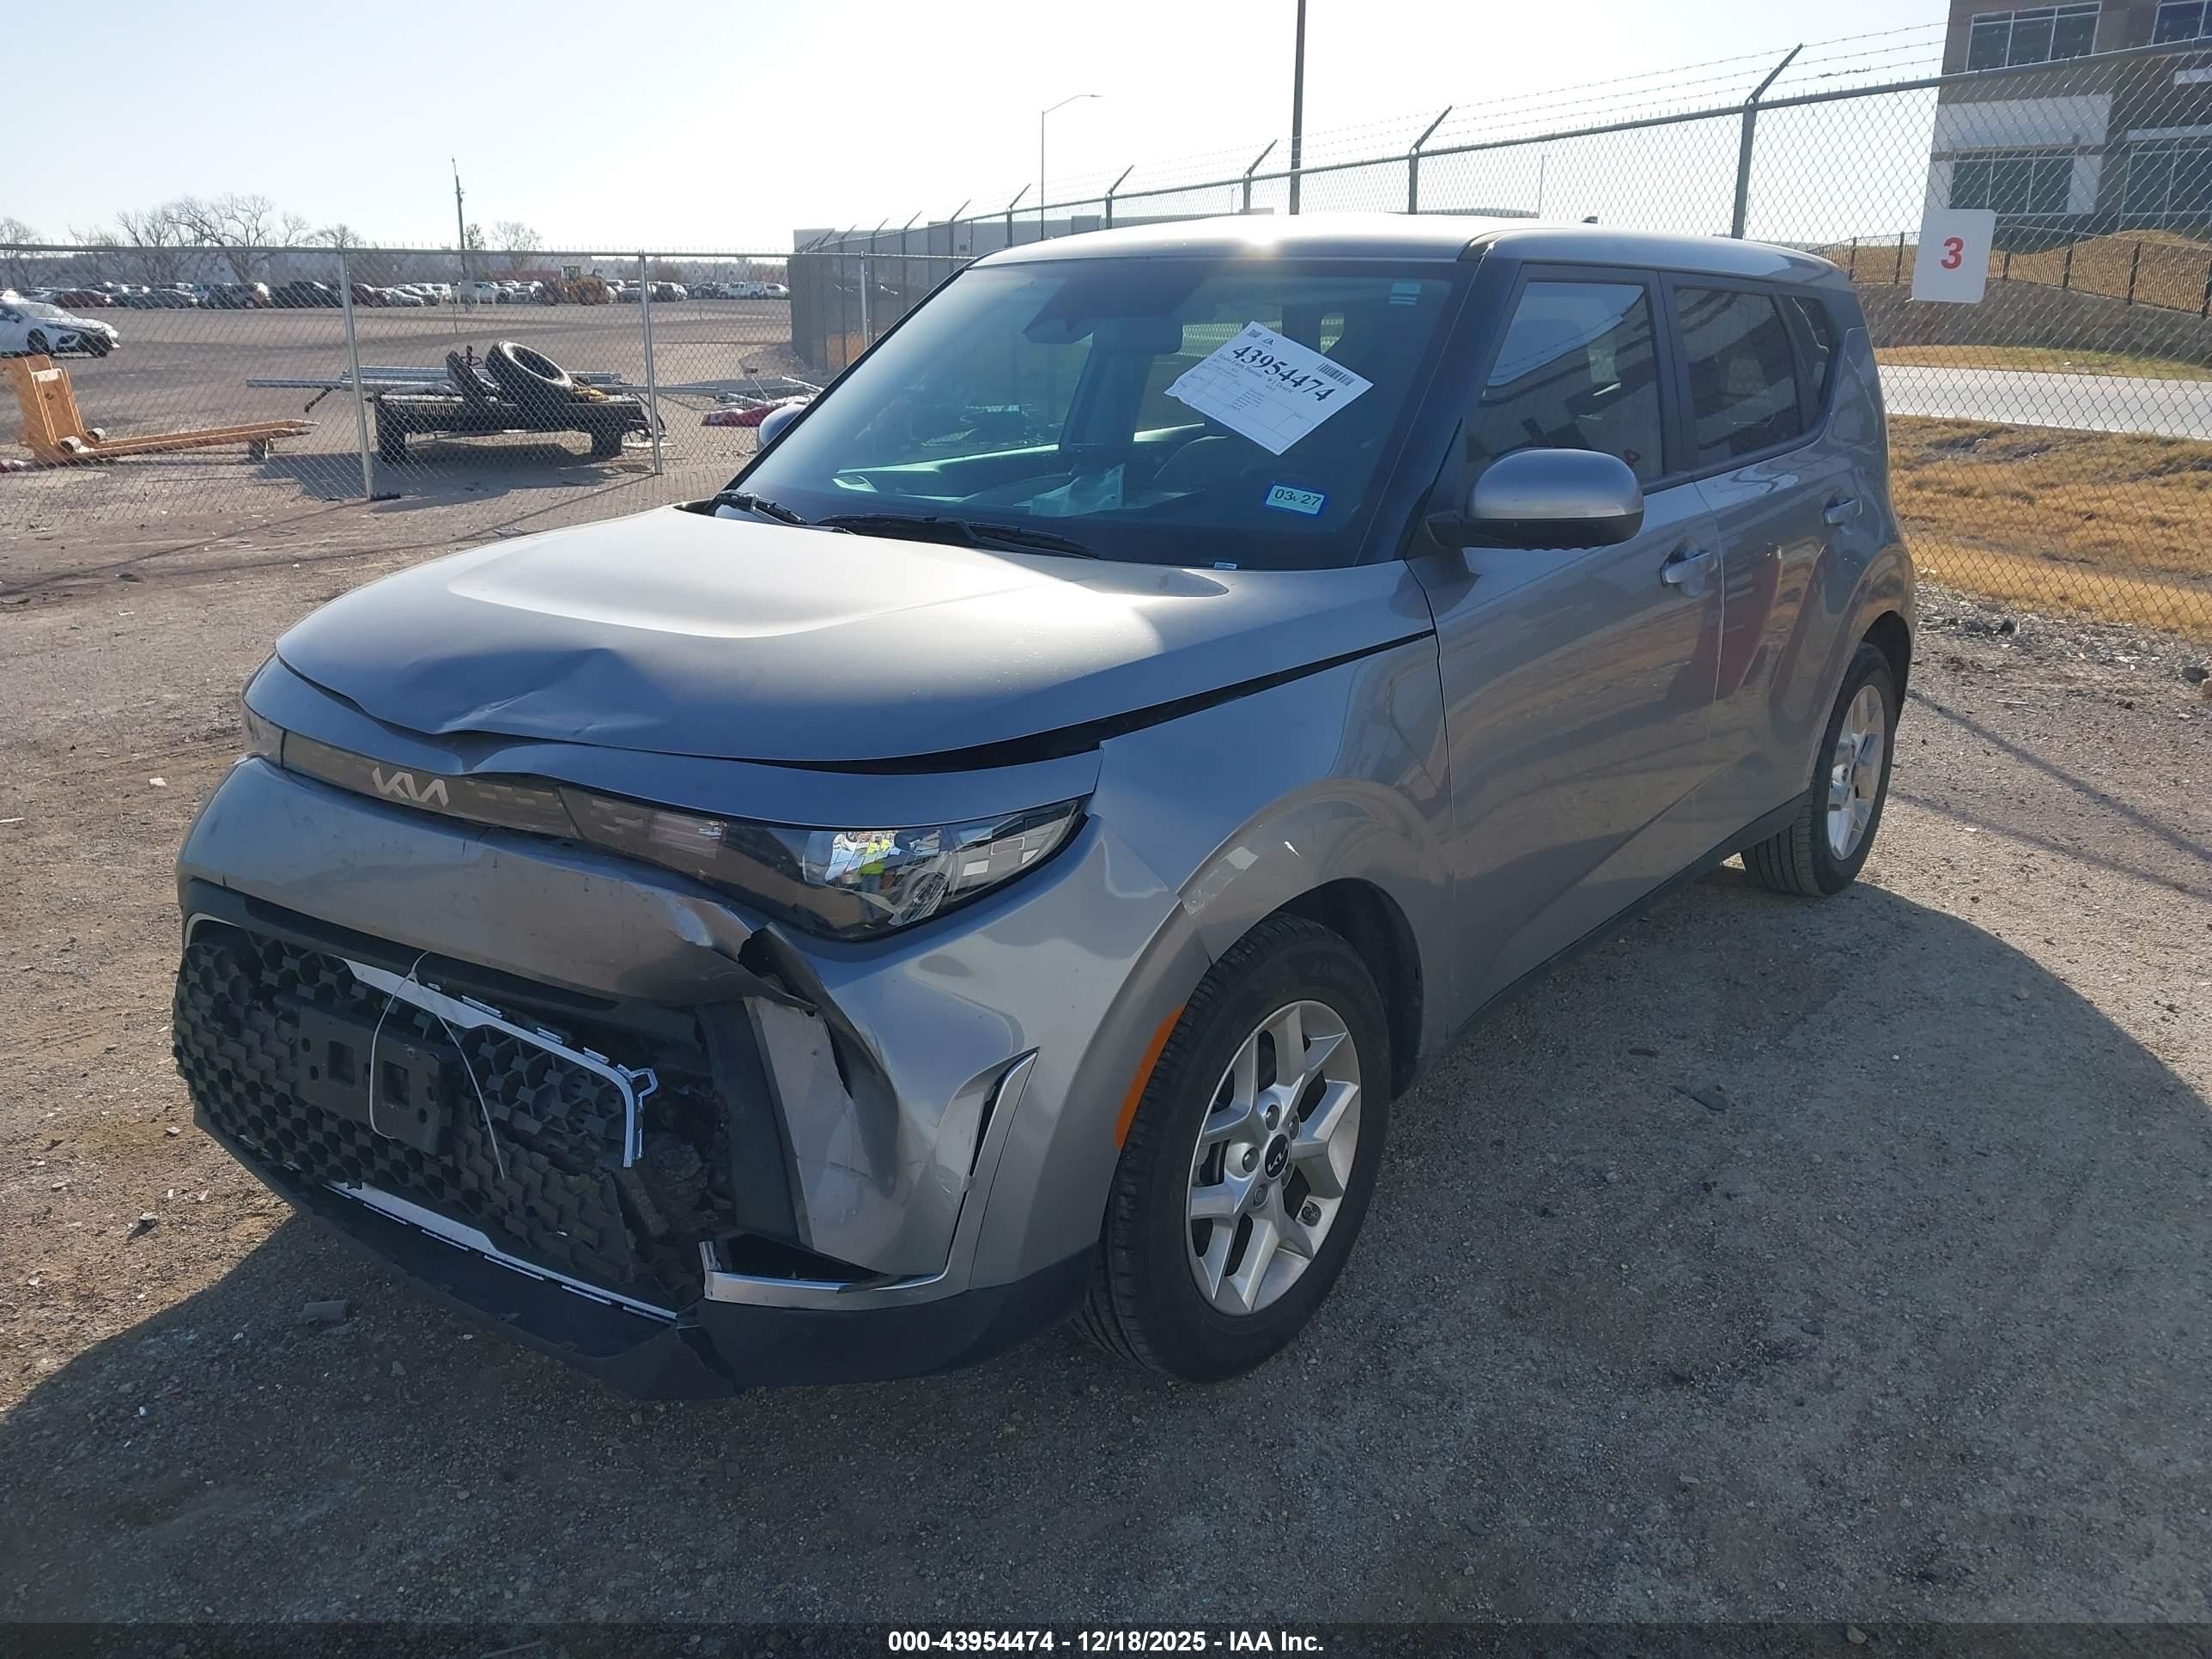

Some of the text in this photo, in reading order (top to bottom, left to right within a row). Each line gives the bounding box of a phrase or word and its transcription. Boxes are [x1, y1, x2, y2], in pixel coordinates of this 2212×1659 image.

[1941, 236, 1964, 270] 3
[1233, 345, 1336, 402] 43954474
[1274, 489, 1322, 506] 03 27
[372, 767, 449, 807] KIA
